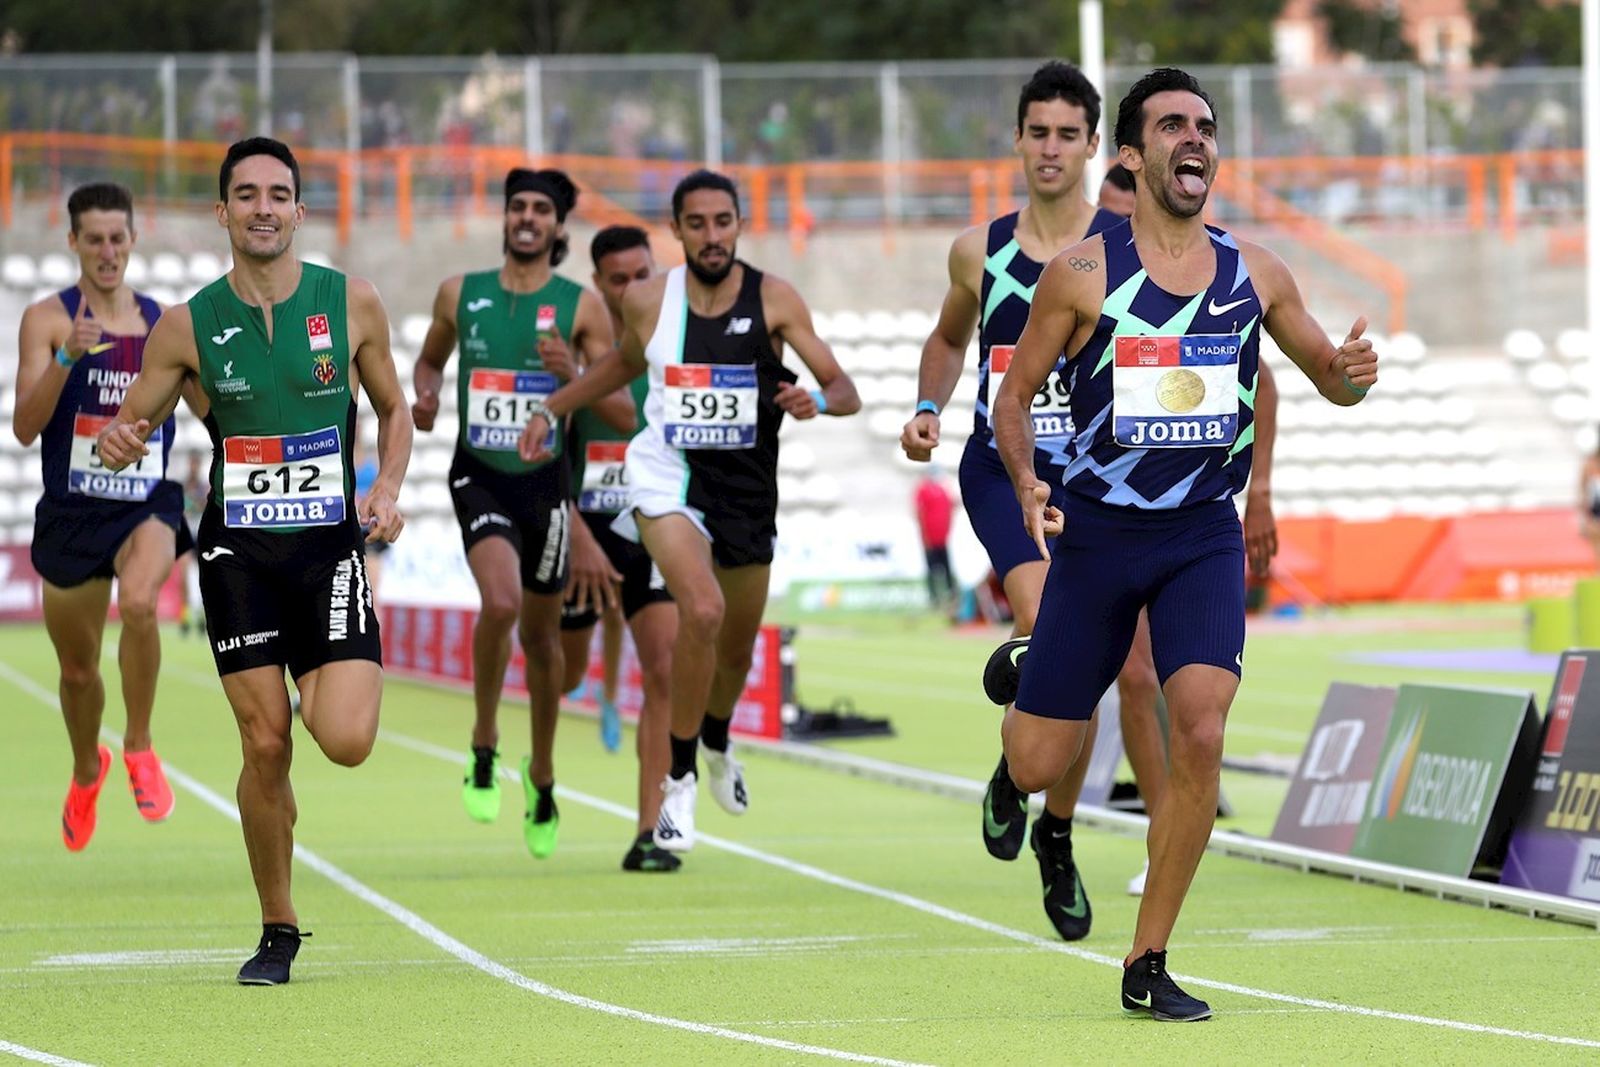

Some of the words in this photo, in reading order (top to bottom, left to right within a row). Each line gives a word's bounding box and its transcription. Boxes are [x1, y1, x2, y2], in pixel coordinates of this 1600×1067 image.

[1197, 345, 1237, 355] MADRID
[681, 393, 738, 420] 593
[1130, 420, 1224, 444] Joma
[299, 438, 335, 453] MADRID
[247, 464, 320, 494] 612
[240, 501, 326, 524] Joma
[217, 636, 241, 653] UJI
